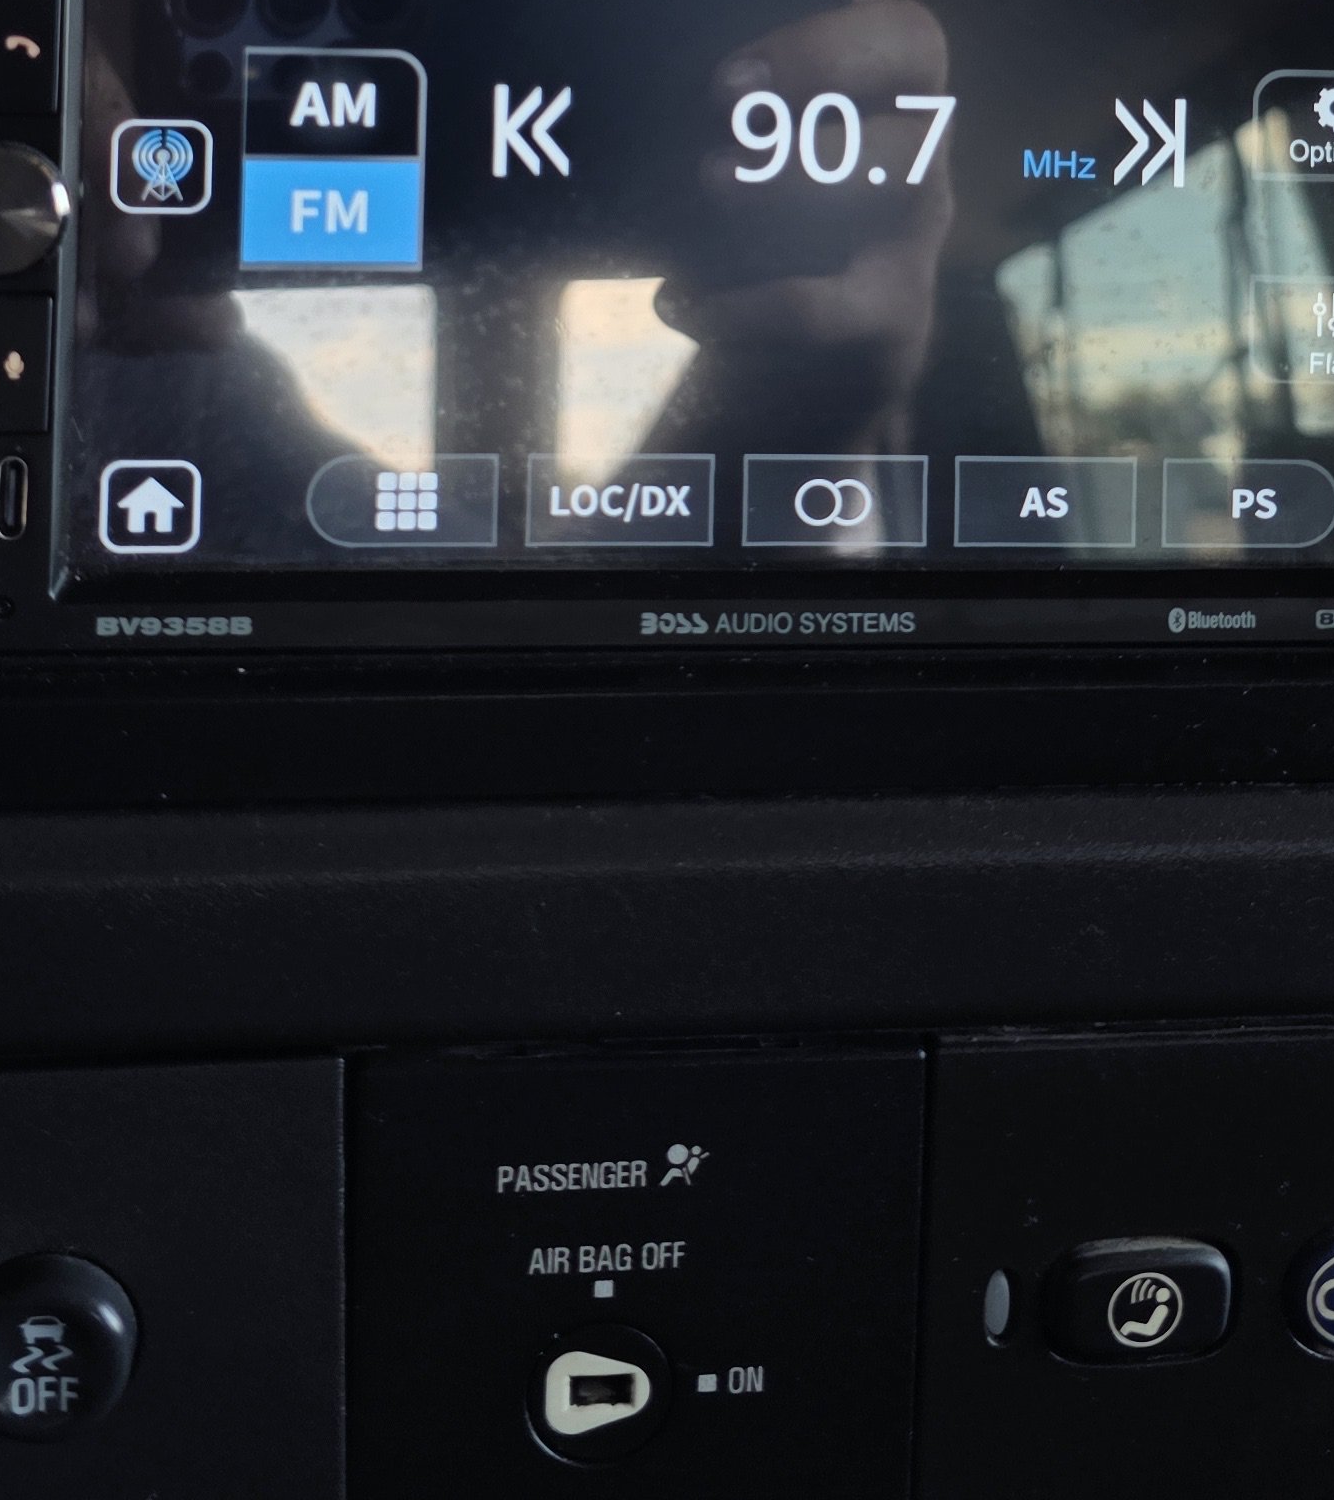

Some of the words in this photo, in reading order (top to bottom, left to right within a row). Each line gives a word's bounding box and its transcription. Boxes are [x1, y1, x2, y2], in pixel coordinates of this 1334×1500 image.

[289, 81, 377, 128] AM
[729, 90, 957, 185] 90.7
[1022, 149, 1097, 180] MHz
[290, 190, 369, 234] FM
[549, 483, 692, 522] LOC/DX
[1020, 485, 1069, 520] AS
[1231, 487, 1278, 520] PS
[95, 616, 254, 637] BV9358B
[715, 612, 793, 634] AUDIO
[799, 612, 916, 634] SYSTEMS
[1187, 610, 1257, 630] Bluetooth
[497, 1161, 648, 1194] PASSENGER
[529, 1246, 571, 1277] AIR
[578, 1244, 634, 1275] BAG
[641, 1241, 687, 1273] OFF
[9, 1376, 80, 1417] OFF
[728, 1366, 766, 1395] ON
